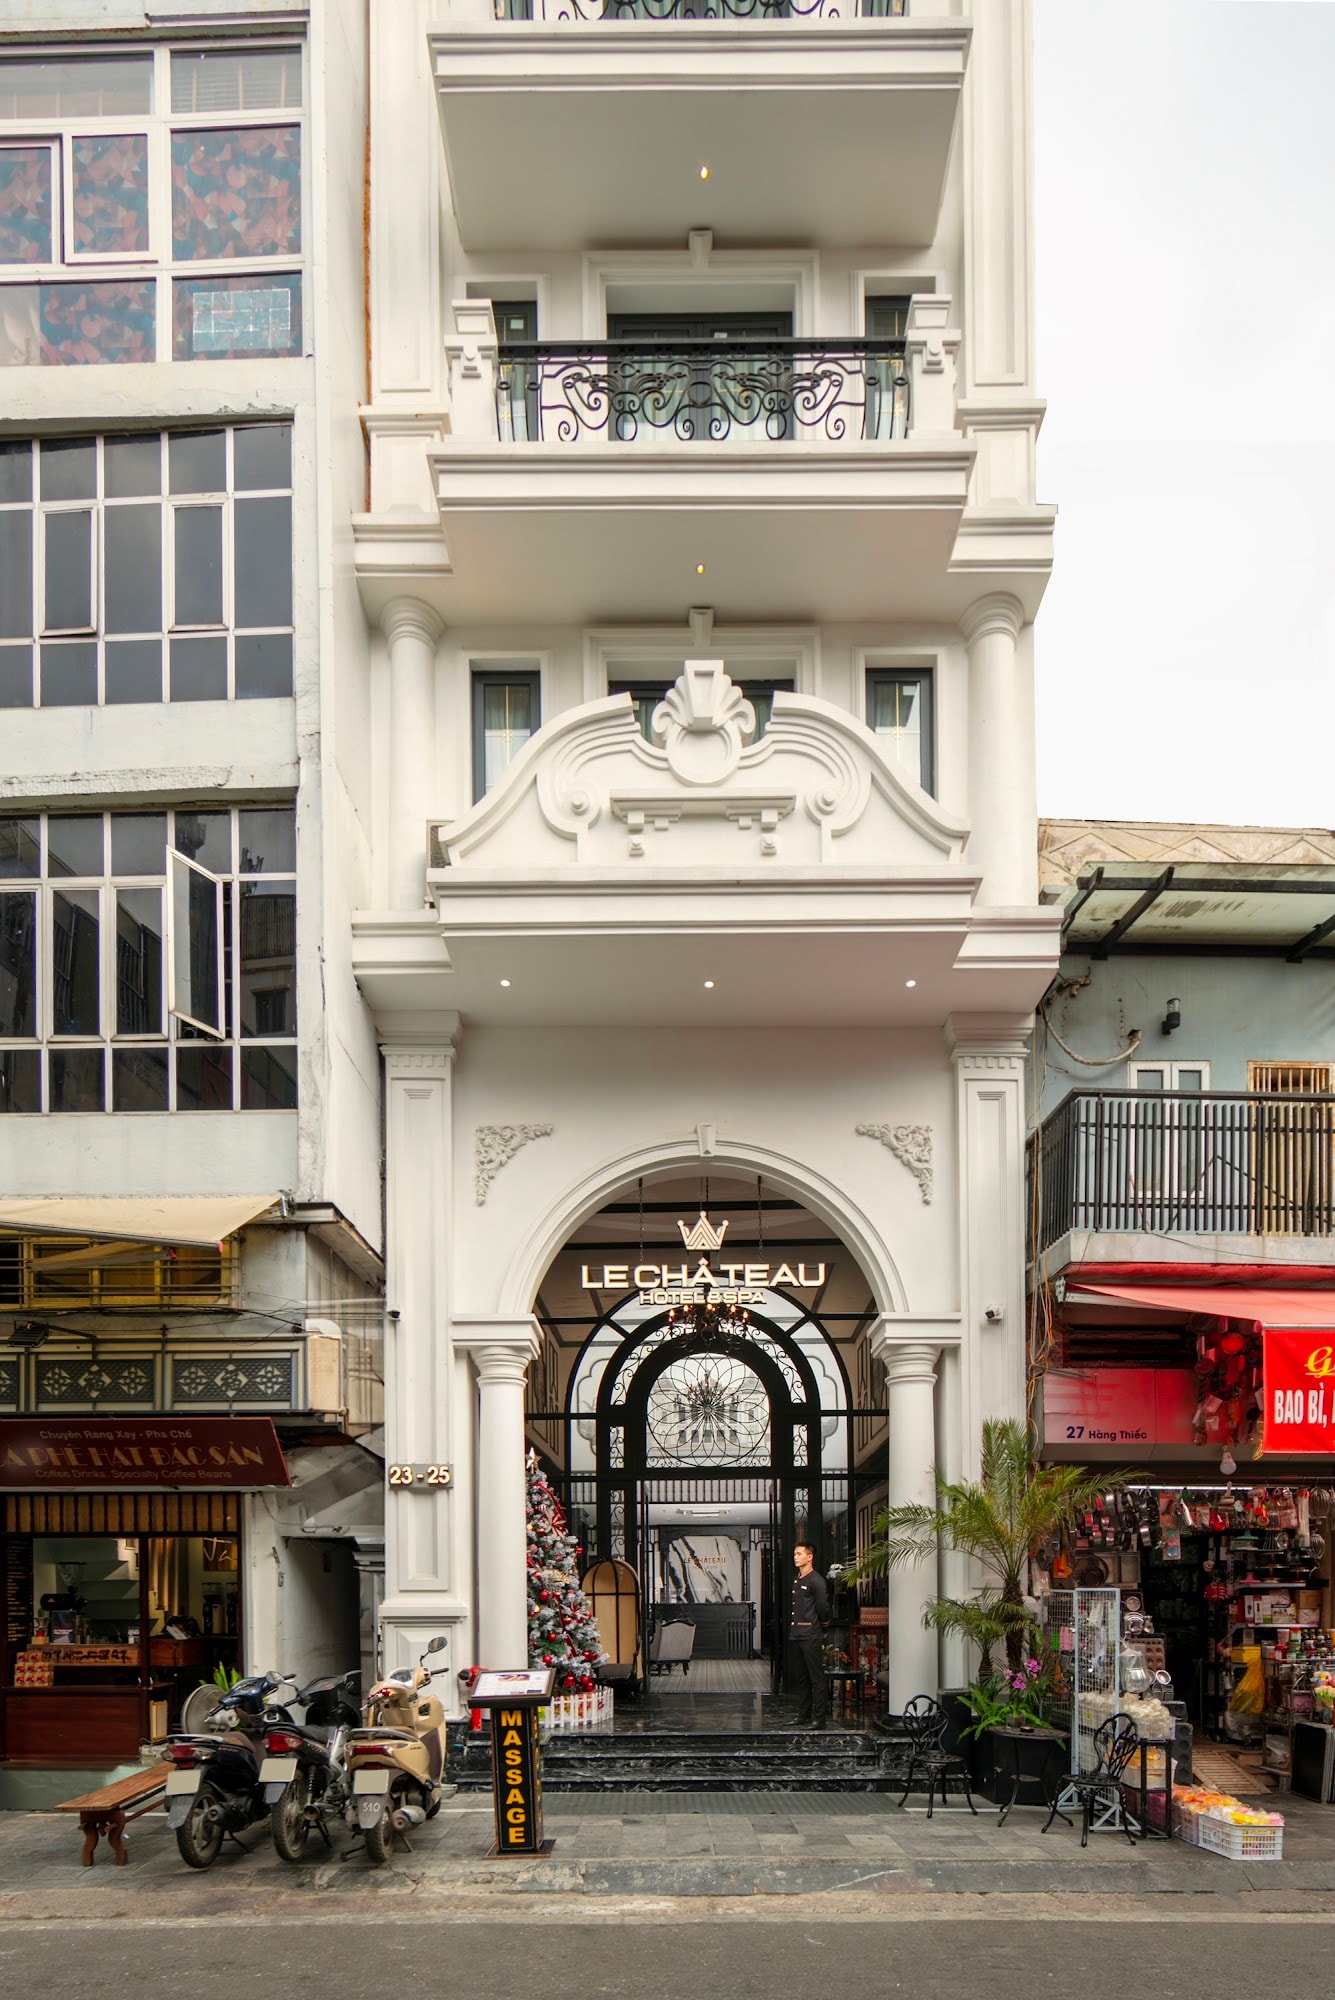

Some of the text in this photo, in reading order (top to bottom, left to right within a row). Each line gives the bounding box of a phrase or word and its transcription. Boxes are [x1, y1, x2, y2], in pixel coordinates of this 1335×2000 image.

[581, 1257, 826, 1289] LE CHÂTEAU
[640, 1290, 706, 1305] HOTEL
[722, 1290, 768, 1304] SPA
[1274, 1389, 1305, 1425] BAO
[1307, 1382, 1328, 1429] BÌ,
[84, 1430, 114, 1441] Rang
[115, 1430, 137, 1440] Xay
[145, 1430, 169, 1439] Pha
[1066, 1426, 1148, 1442] 27 Hàng Thiếc
[207, 1440, 264, 1466] SẢN
[35, 1469, 71, 1479] Coffee
[110, 1469, 159, 1481] Specialty
[161, 1469, 196, 1479] Coffee
[198, 1469, 232, 1479] Beans
[389, 1466, 413, 1484] 23
[427, 1465, 451, 1484] 25
[501, 1710, 526, 1843] MASSAGE
